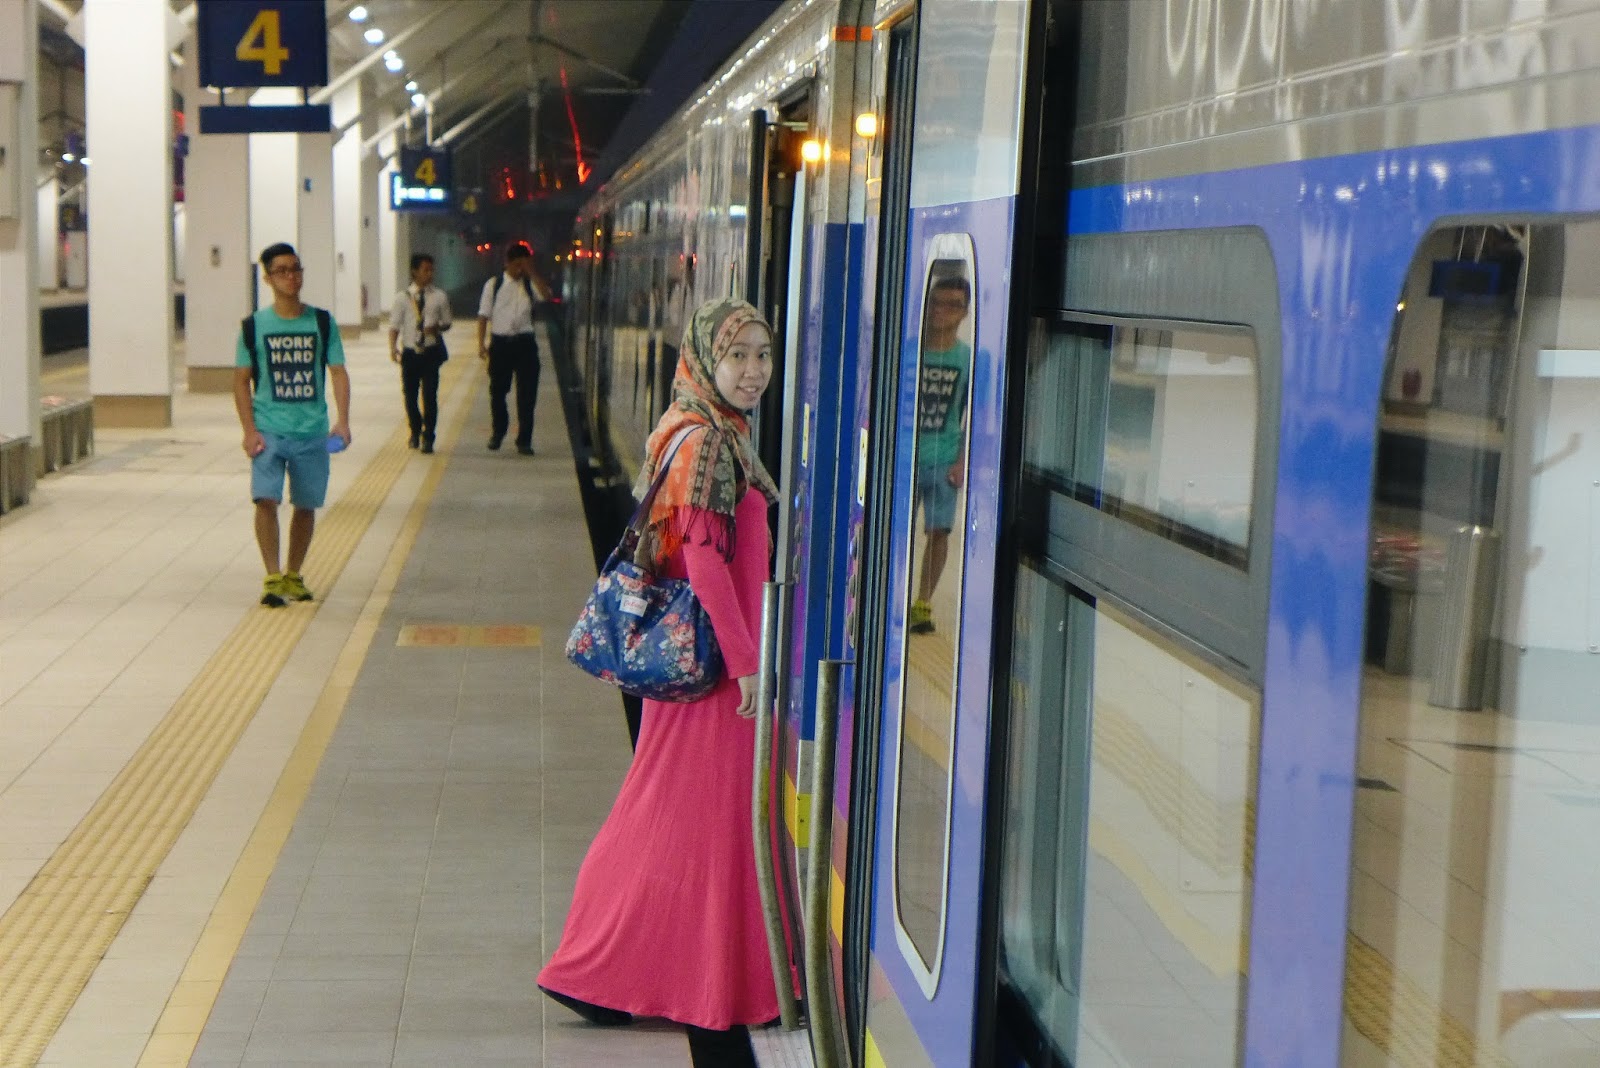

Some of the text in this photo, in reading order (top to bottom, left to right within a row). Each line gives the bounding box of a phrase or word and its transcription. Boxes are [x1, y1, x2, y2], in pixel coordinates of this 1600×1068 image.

[235, 9, 290, 75] 4
[415, 158, 436, 186] 4
[267, 336, 314, 349] WORK
[271, 350, 314, 364] HARD
[273, 370, 313, 384] PLAY
[275, 385, 314, 398] HARD
